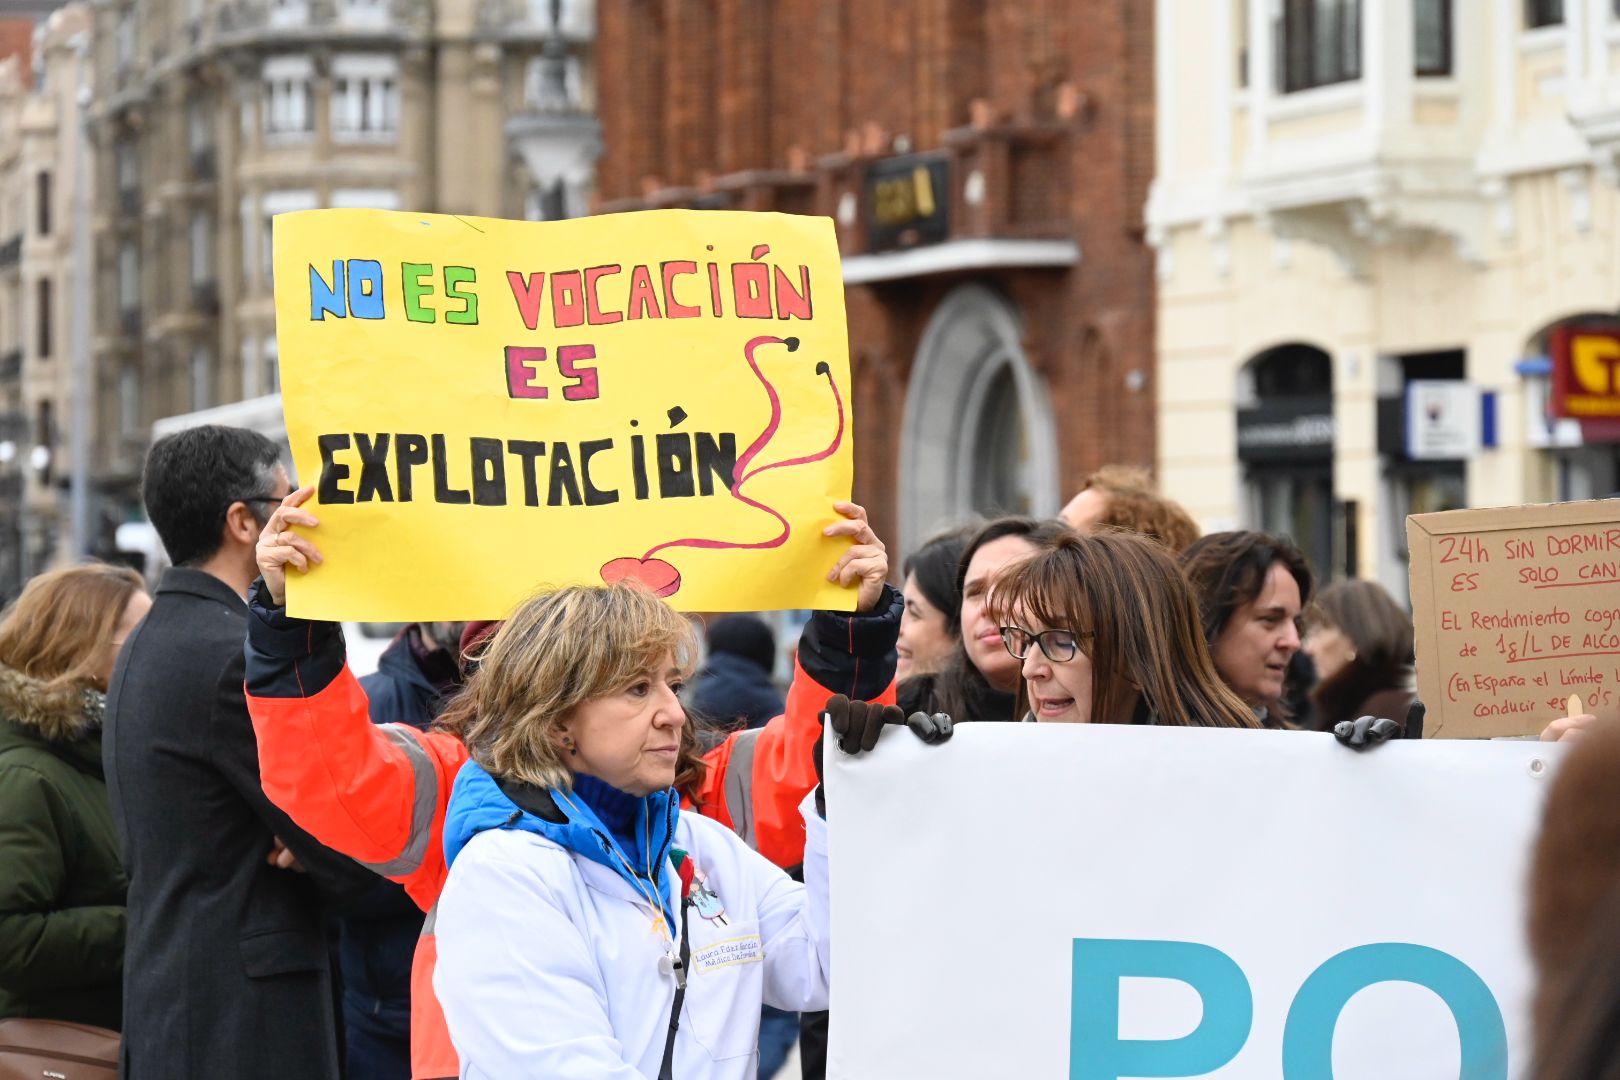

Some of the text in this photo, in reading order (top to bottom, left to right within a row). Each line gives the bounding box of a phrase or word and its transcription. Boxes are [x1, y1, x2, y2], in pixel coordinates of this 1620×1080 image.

[309, 259, 385, 321] NO
[401, 262, 479, 325] ES
[504, 344, 600, 401] ES
[317, 406, 739, 507] EXPLOTACIÓN
[1439, 536, 1489, 563] 24h
[1450, 573, 1480, 592] ES
[1518, 567, 1559, 583] SOLO
[1471, 606, 1570, 630] Rendimiento
[1459, 643, 1478, 657] de
[1551, 635, 1571, 649] DE
[1448, 672, 1471, 702] (En
[1473, 674, 1526, 696] España
[1533, 671, 1549, 686] el
[1547, 696, 1567, 710] es
